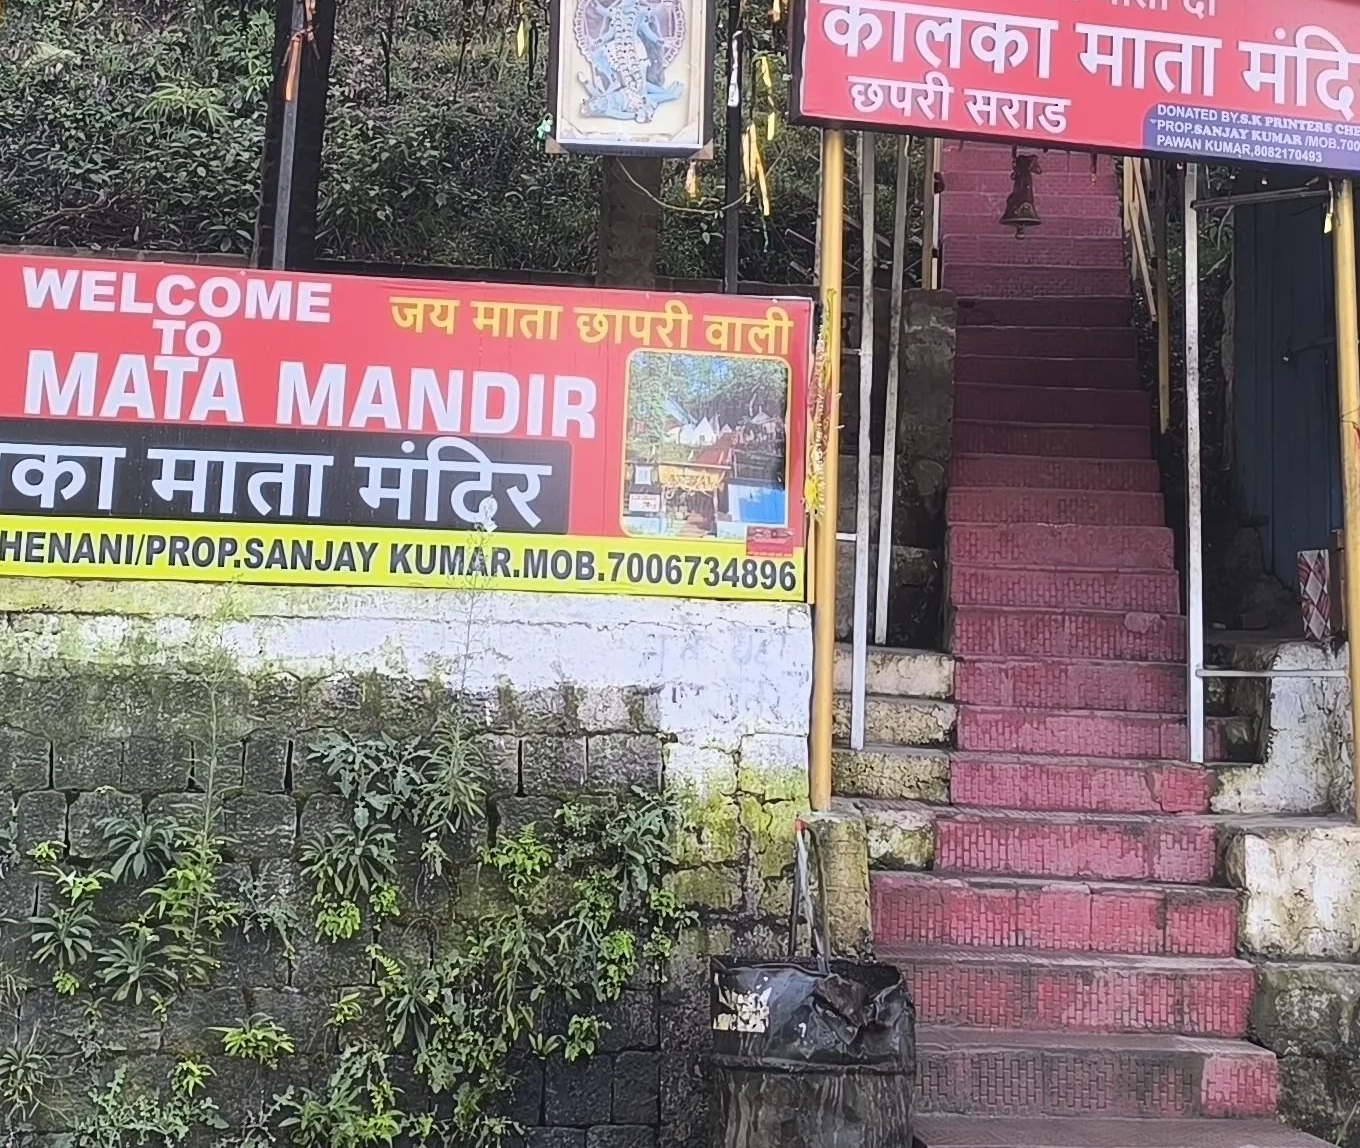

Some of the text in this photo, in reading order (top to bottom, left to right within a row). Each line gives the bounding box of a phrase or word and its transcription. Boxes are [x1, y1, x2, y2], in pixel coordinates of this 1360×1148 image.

[1075, 22, 1222, 96] माता
[847, 71, 1071, 133] छपरी सराड
[1157, 104, 1217, 121] DONATED
[1265, 116, 1333, 134] PRINTERS
[1157, 121, 1249, 140] PROP.SANJAY
[1251, 130, 1303, 146] KUMAR
[1157, 134, 1202, 151] PAWAN
[22, 267, 332, 323] WELCOME
[152, 319, 221, 357] TO
[389, 297, 793, 354] जय माता छापरी वाली
[23, 349, 244, 422] MATA
[276, 361, 597, 439] MANDIR
[147, 448, 334, 517] माता
[354, 436, 552, 532] मंदिर
